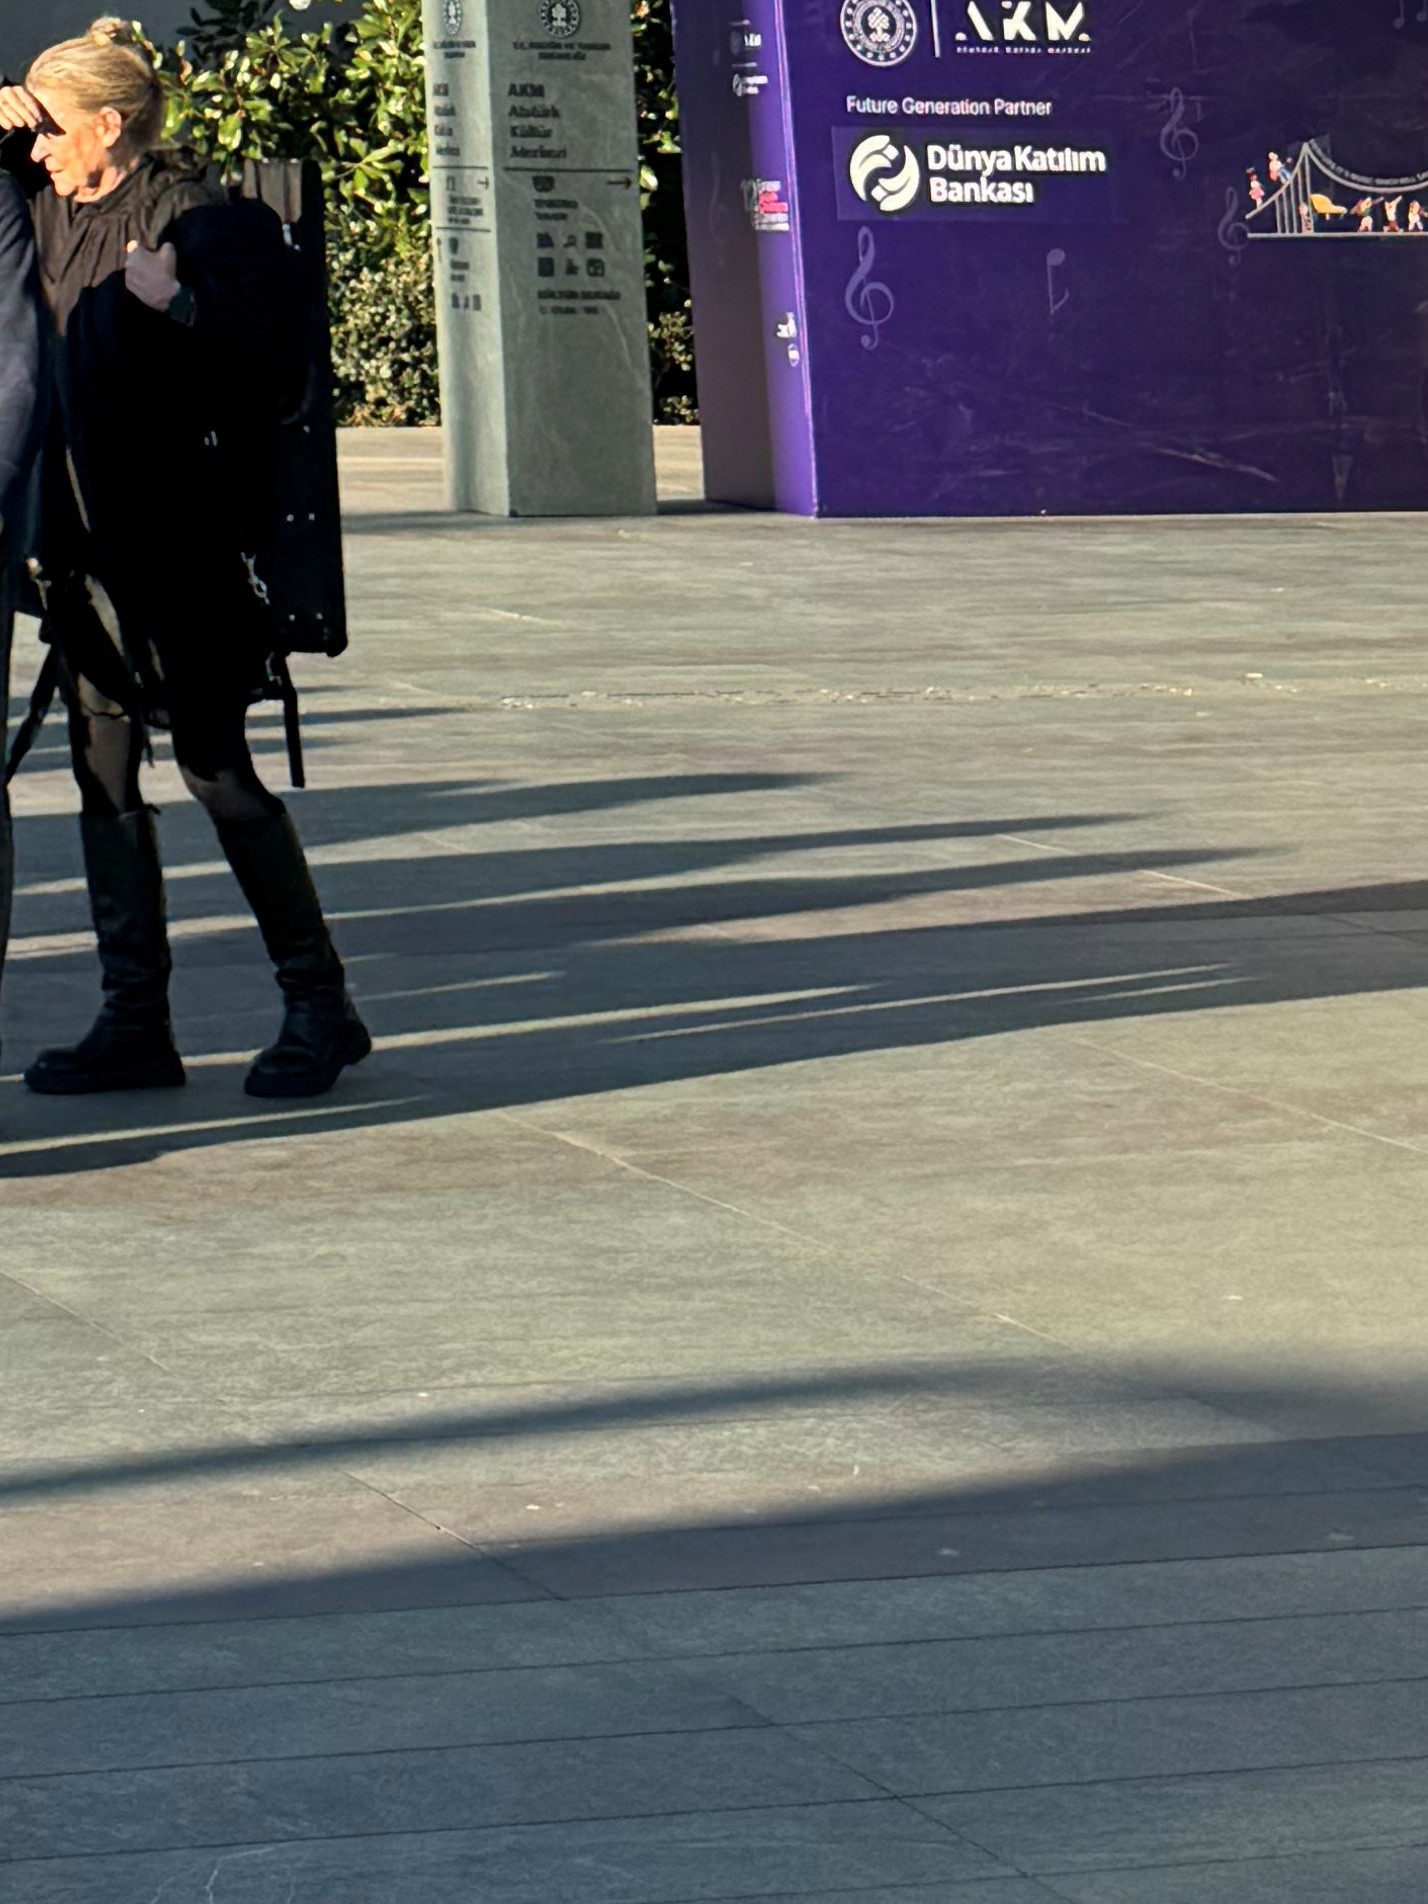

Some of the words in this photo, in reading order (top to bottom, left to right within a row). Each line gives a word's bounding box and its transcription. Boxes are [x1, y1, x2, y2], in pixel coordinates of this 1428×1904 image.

[846, 95, 899, 114] Future
[902, 96, 990, 115] Generation
[994, 98, 1052, 116] Partner
[927, 144, 1012, 177] Dünya
[1014, 145, 1106, 172] Katılım
[929, 176, 1035, 203] Bankası
